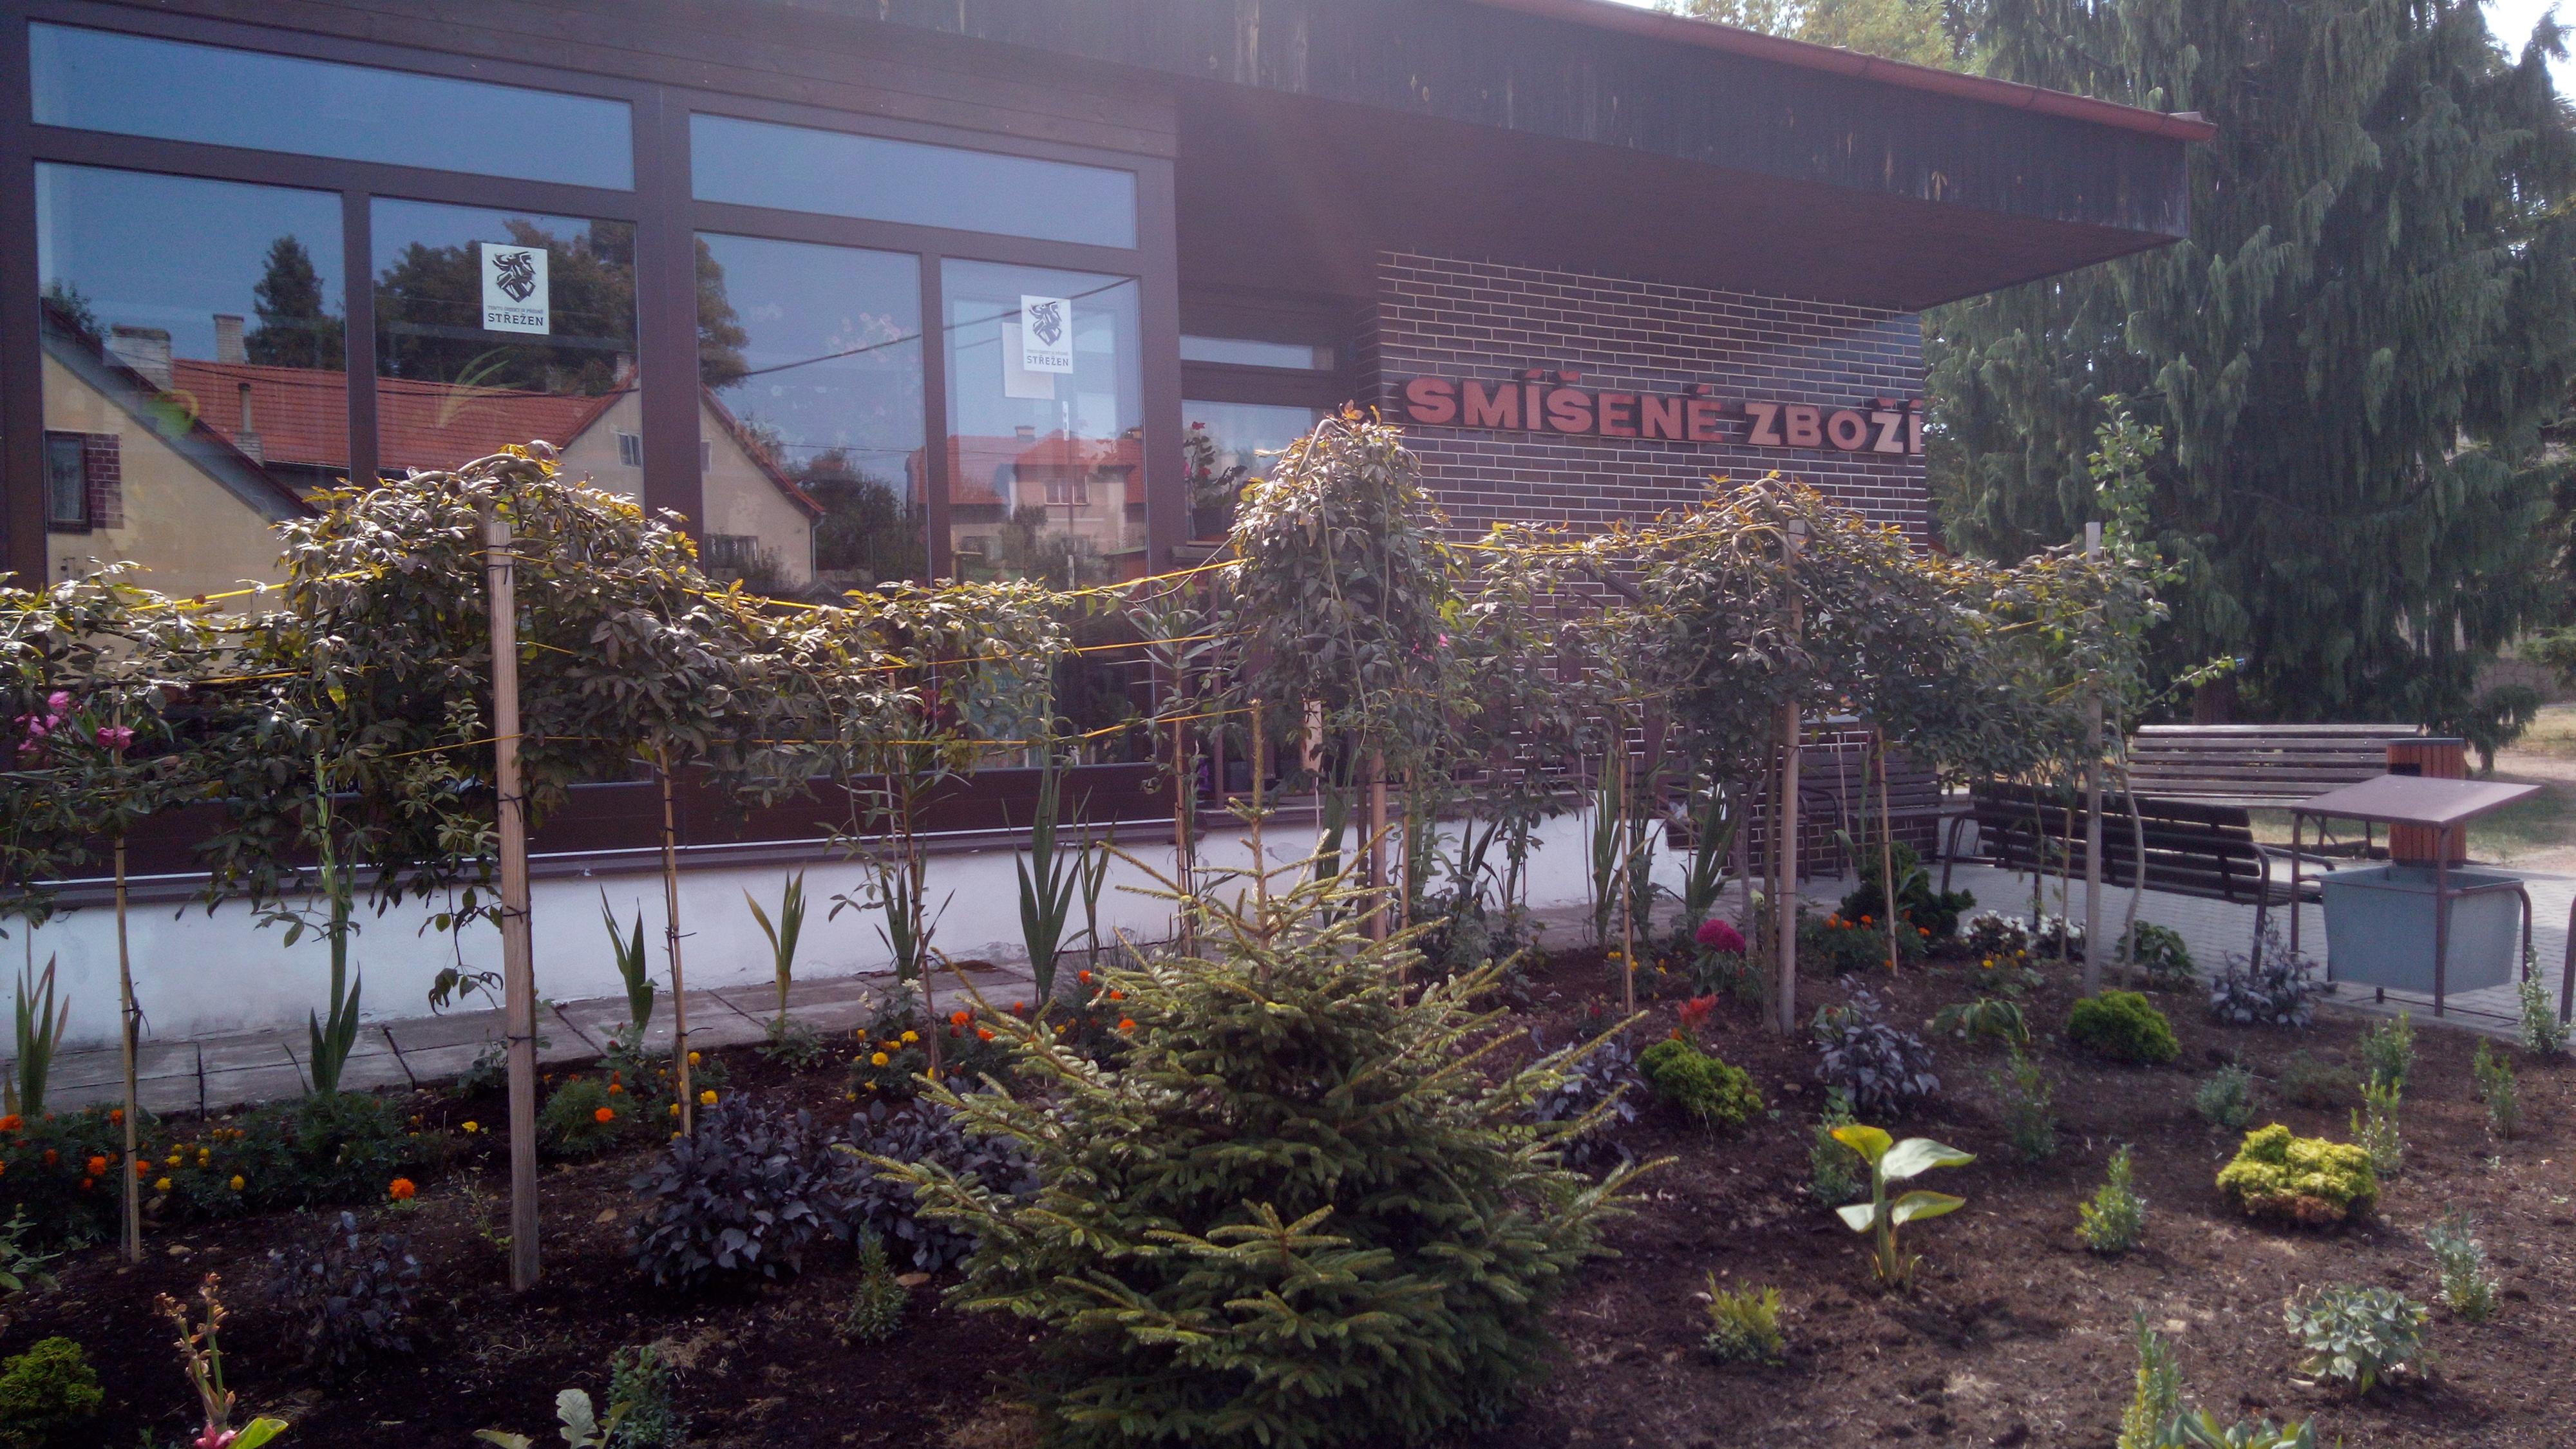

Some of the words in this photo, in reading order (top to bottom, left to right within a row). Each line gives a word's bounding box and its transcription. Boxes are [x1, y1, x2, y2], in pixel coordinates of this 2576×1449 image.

[488, 312, 544, 326] STŘEŽEN
[1027, 355, 1069, 366] STŘEŽEN
[1406, 368, 1723, 442] SMÍŠENÉ
[1745, 397, 1923, 453] ZBOŽÍ
